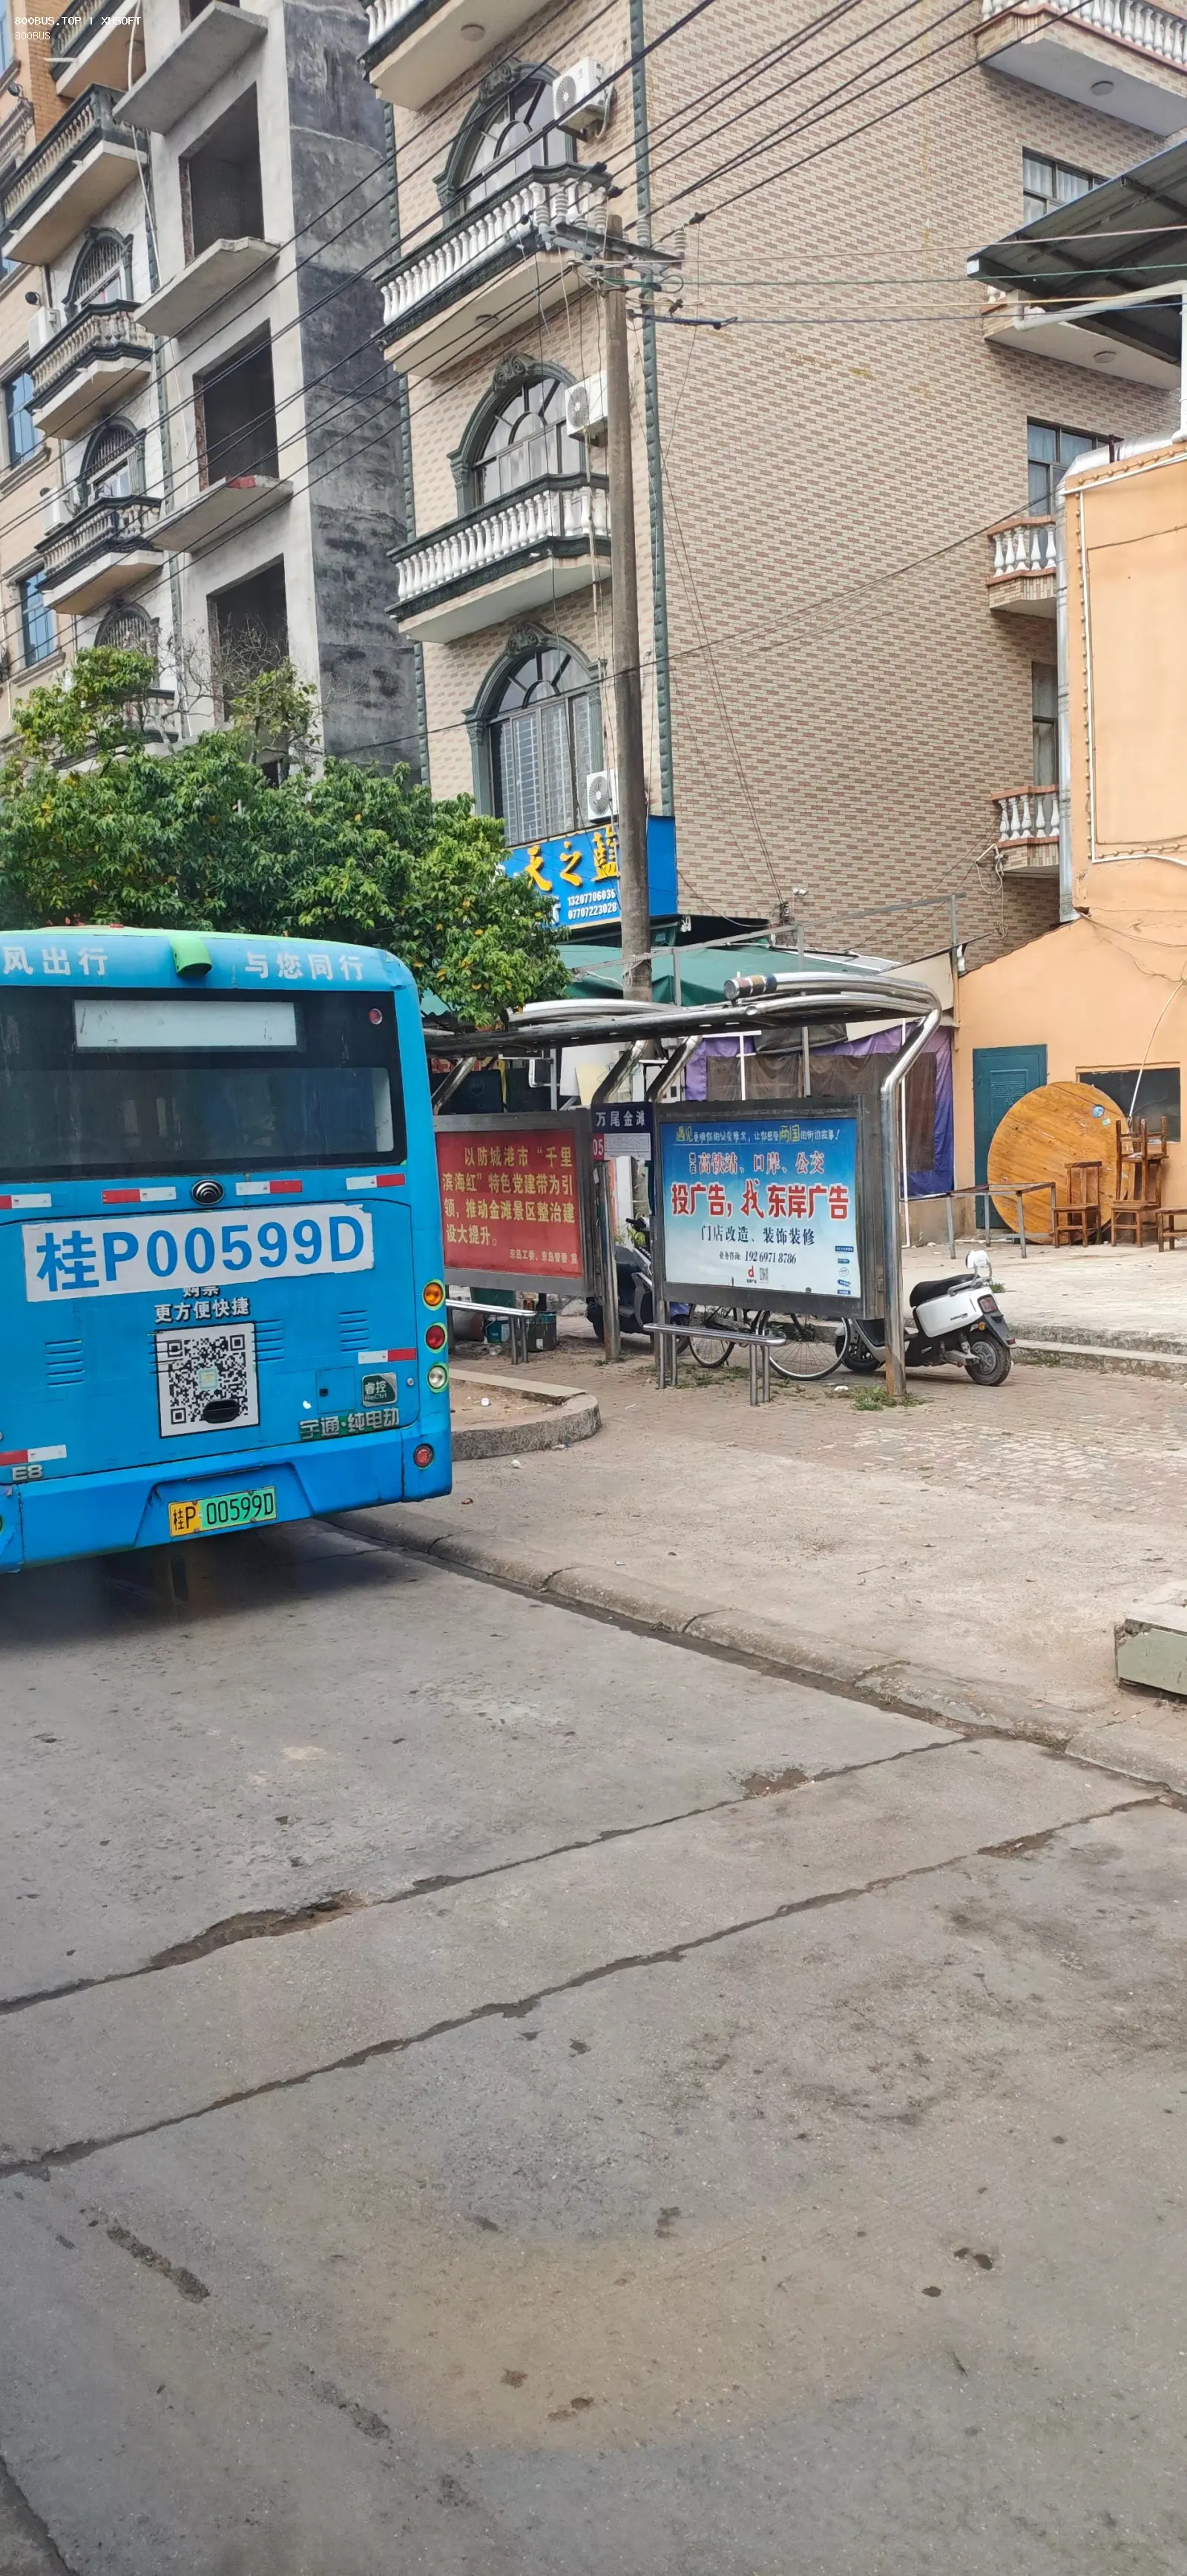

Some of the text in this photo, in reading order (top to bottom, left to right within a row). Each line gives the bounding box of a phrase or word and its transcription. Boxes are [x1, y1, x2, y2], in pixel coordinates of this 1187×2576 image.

[567, 889, 616, 905] 13207706036
[568, 902, 618, 920] 07707223028
[3, 945, 364, 981] 风出行 与您同行
[595, 1110, 646, 1127] 万尾金滩
[698, 1150, 825, 1175] 高铁站、口岸、公交
[701, 1225, 815, 1246] 门店改造、装饰装修
[36, 1214, 365, 1294] 桂P00599D
[745, 1251, 757, 1262] 192
[759, 1252, 776, 1263] 6971
[777, 1253, 797, 1265] 8786
[154, 1297, 250, 1324] 更方便快捷
[364, 1380, 387, 1395] 睿控
[12, 1464, 43, 1481] E8
